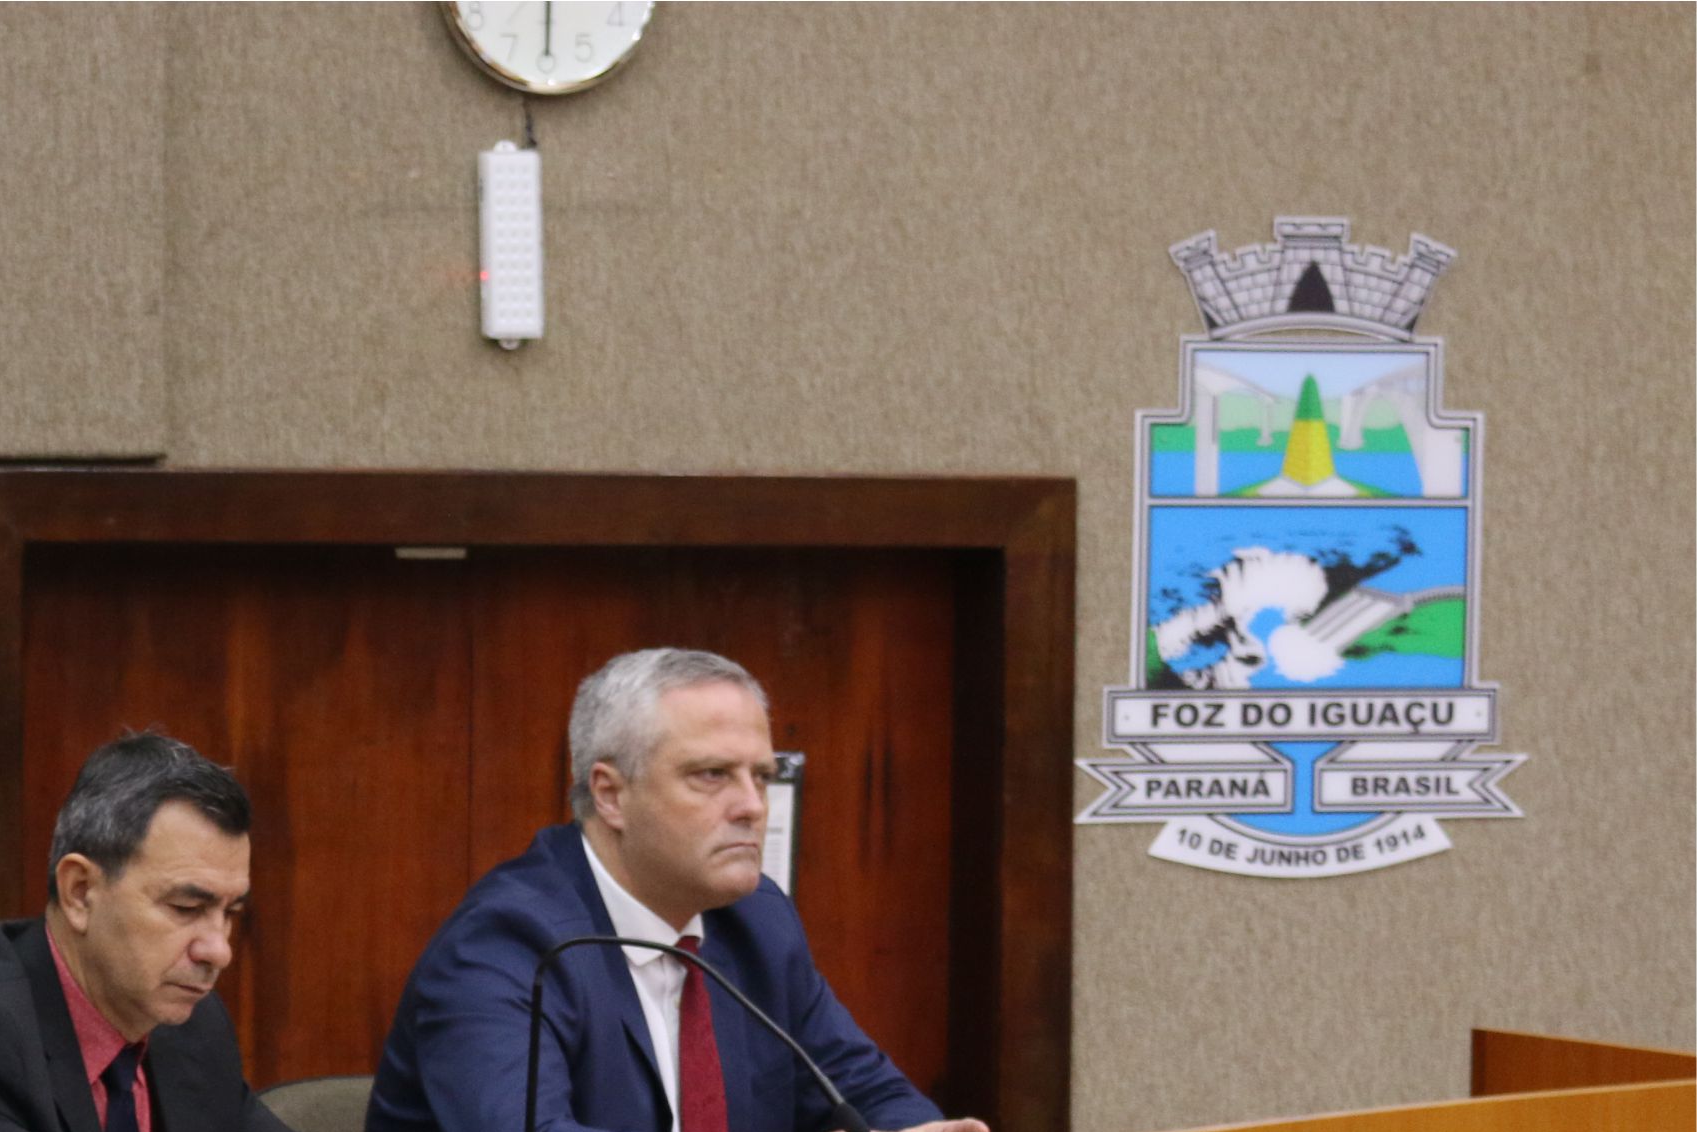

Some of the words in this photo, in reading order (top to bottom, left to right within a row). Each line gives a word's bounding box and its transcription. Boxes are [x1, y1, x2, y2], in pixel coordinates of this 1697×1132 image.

[500, 32, 519, 62] 7
[574, 32, 594, 63] 5
[1150, 702, 1226, 728] FOZ
[1241, 702, 1293, 728] DO
[1308, 701, 1455, 735] IGUAÇU
[1145, 772, 1271, 798] PARANÁ
[1351, 775, 1460, 797] BRASIL
[1177, 828, 1202, 850] 10
[1208, 838, 1239, 861] DE
[1246, 848, 1328, 867] JUNHO
[1336, 845, 1366, 863] DE
[1373, 824, 1426, 854] 1914
